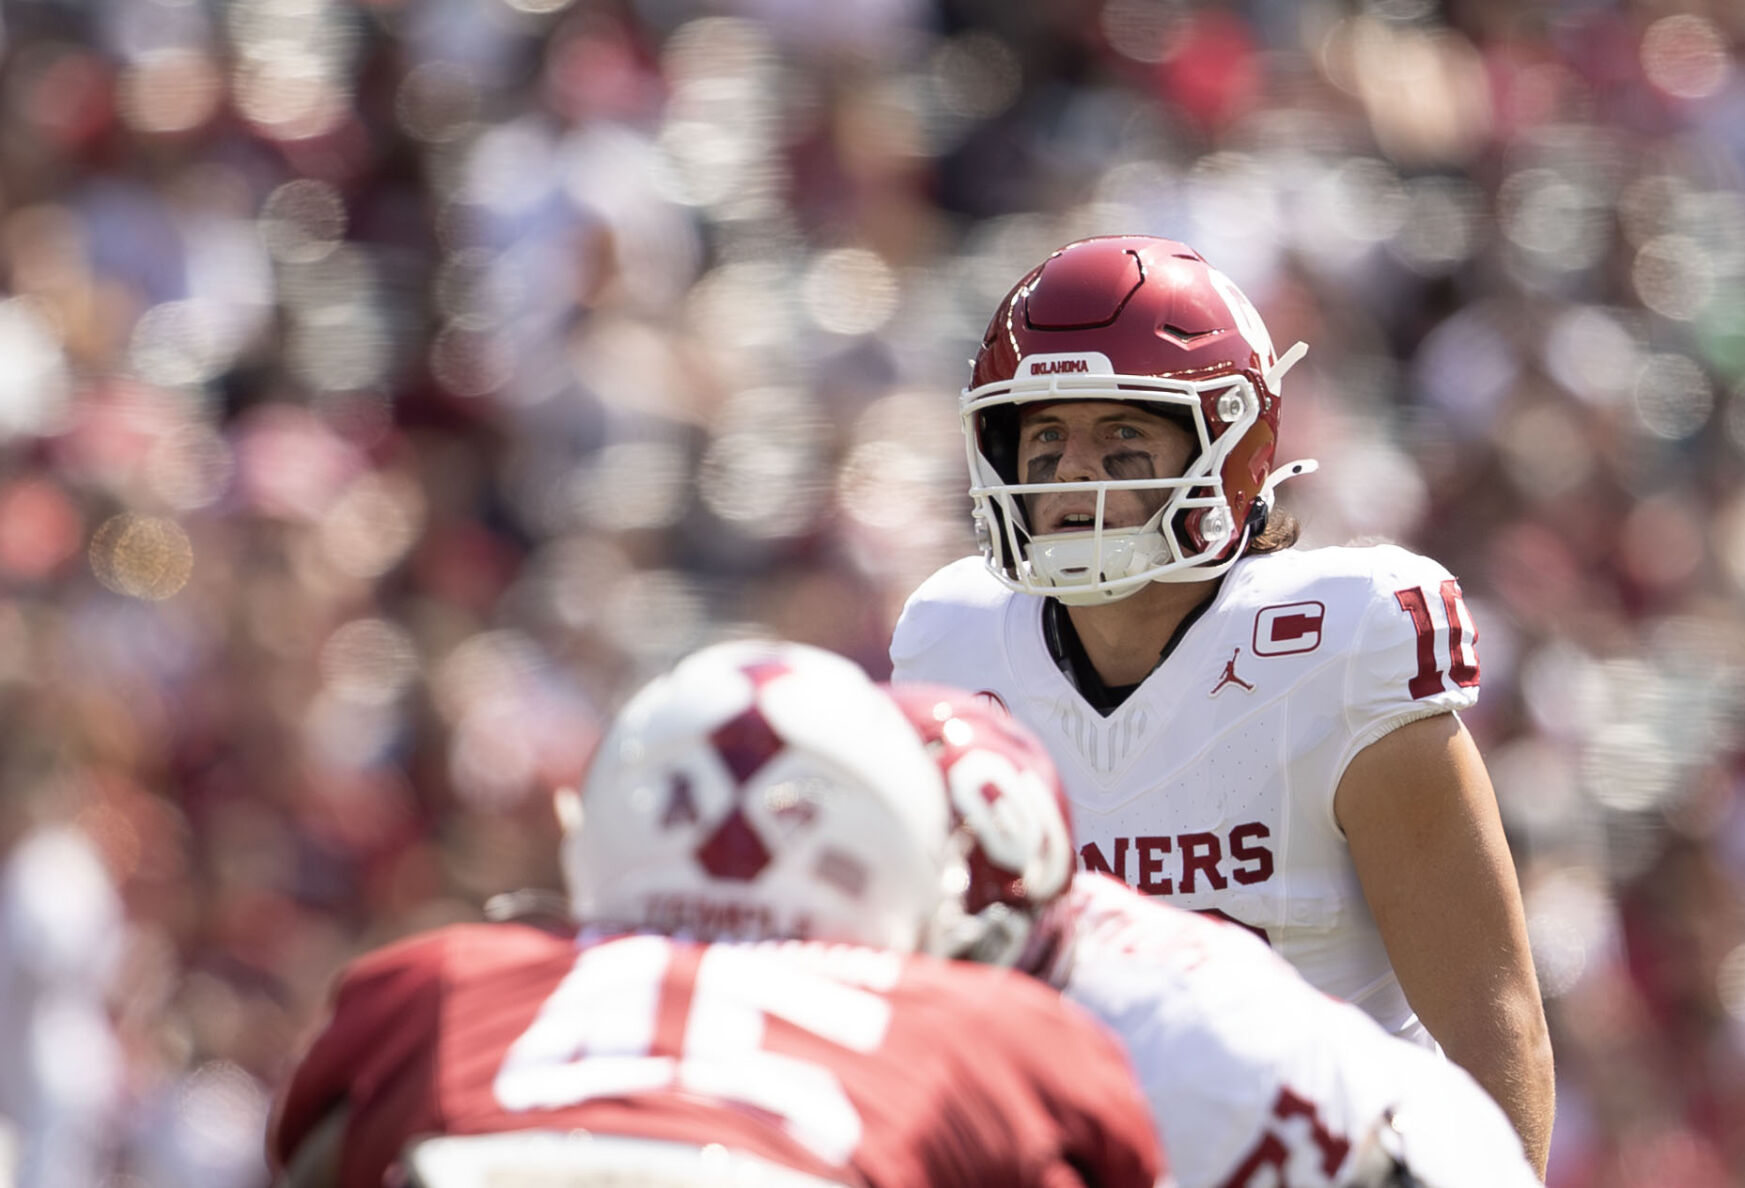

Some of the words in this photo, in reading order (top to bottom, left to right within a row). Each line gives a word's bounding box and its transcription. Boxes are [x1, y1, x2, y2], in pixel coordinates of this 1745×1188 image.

[1031, 360, 1088, 375] OKLAHOMA
[1253, 600, 1325, 656] C
[1395, 577, 1480, 700] 10
